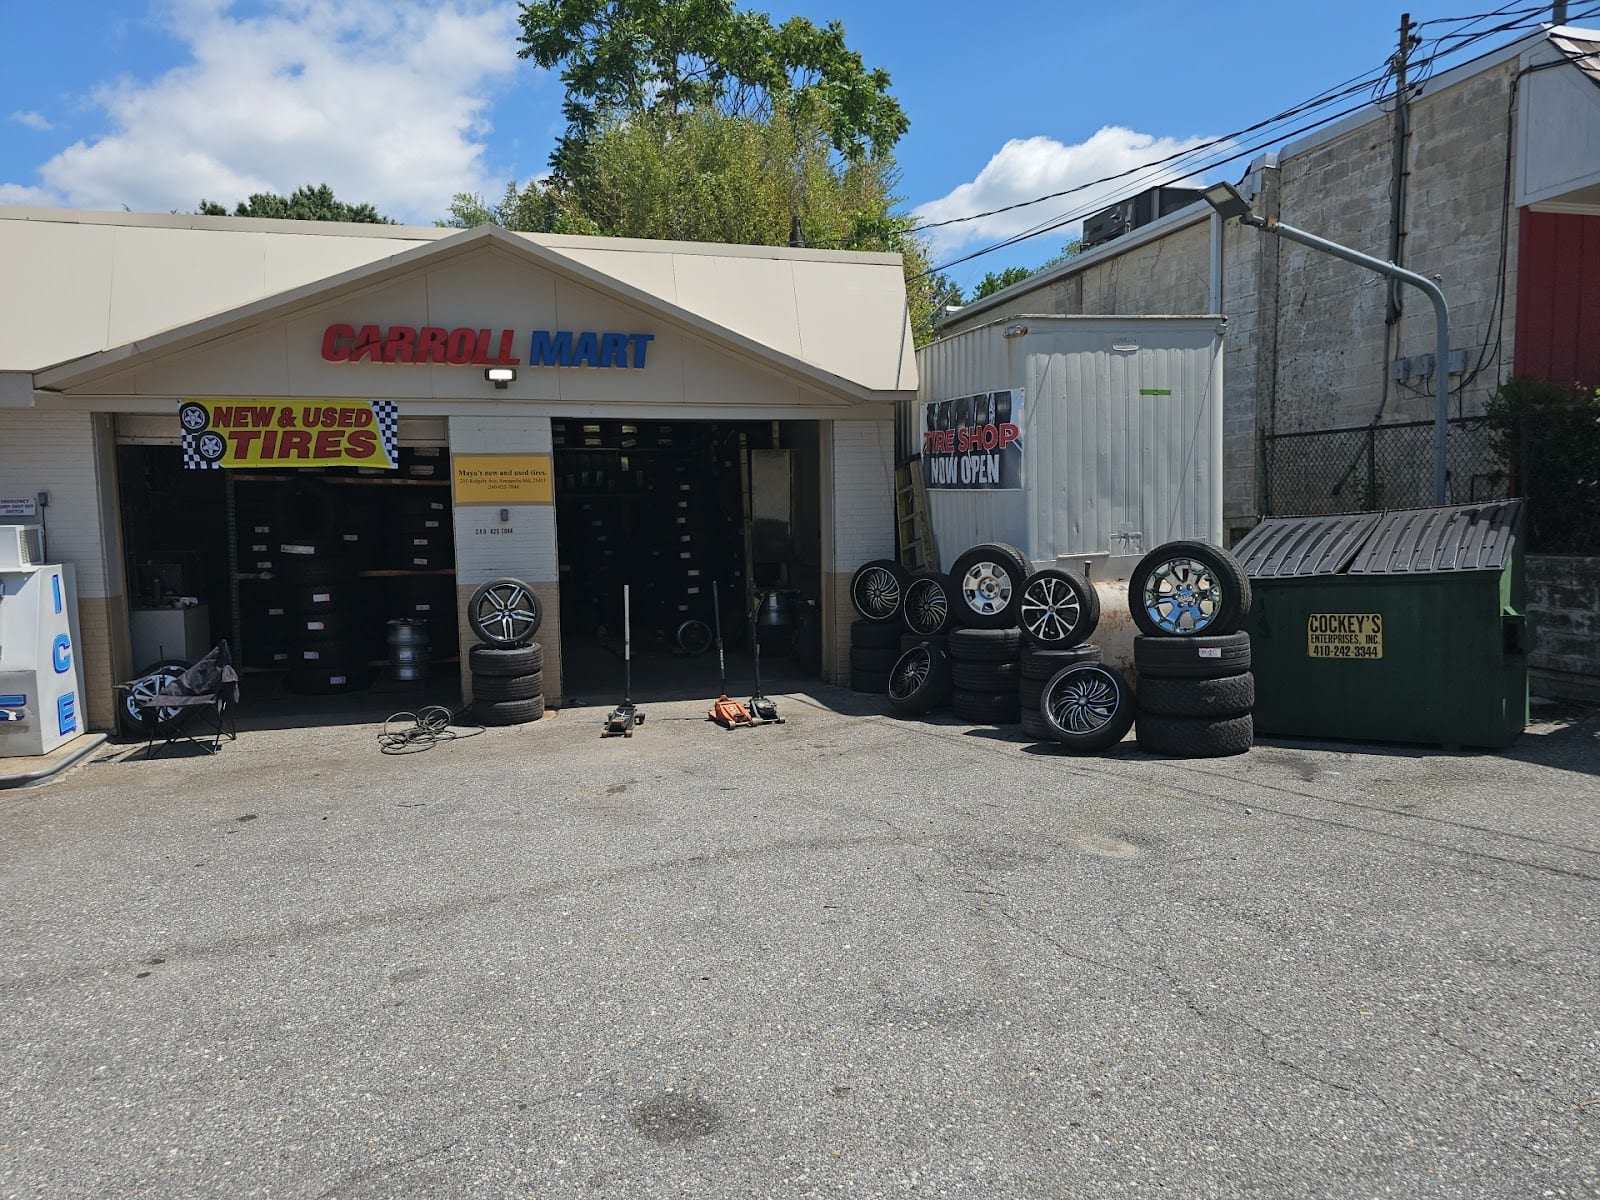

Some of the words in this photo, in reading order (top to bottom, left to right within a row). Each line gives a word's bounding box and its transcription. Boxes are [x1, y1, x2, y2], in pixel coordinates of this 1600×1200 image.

[321, 323, 521, 366] CARROLL
[529, 330, 655, 370] MART
[212, 406, 276, 428] NEW
[277, 407, 296, 428] &
[302, 407, 373, 428] USED
[228, 430, 377, 459] TIRES
[923, 428, 955, 454] TIRE
[958, 423, 1020, 453] SHOP
[931, 456, 958, 484] NOW
[961, 454, 1000, 484] OPEN
[1310, 614, 1381, 634] COCKEY'S
[1311, 634, 1362, 645] ENTERPRISES,
[1365, 634, 1381, 645] INC.
[1313, 645, 1378, 657] 410-242-3344
[52, 574, 77, 736] ICE
